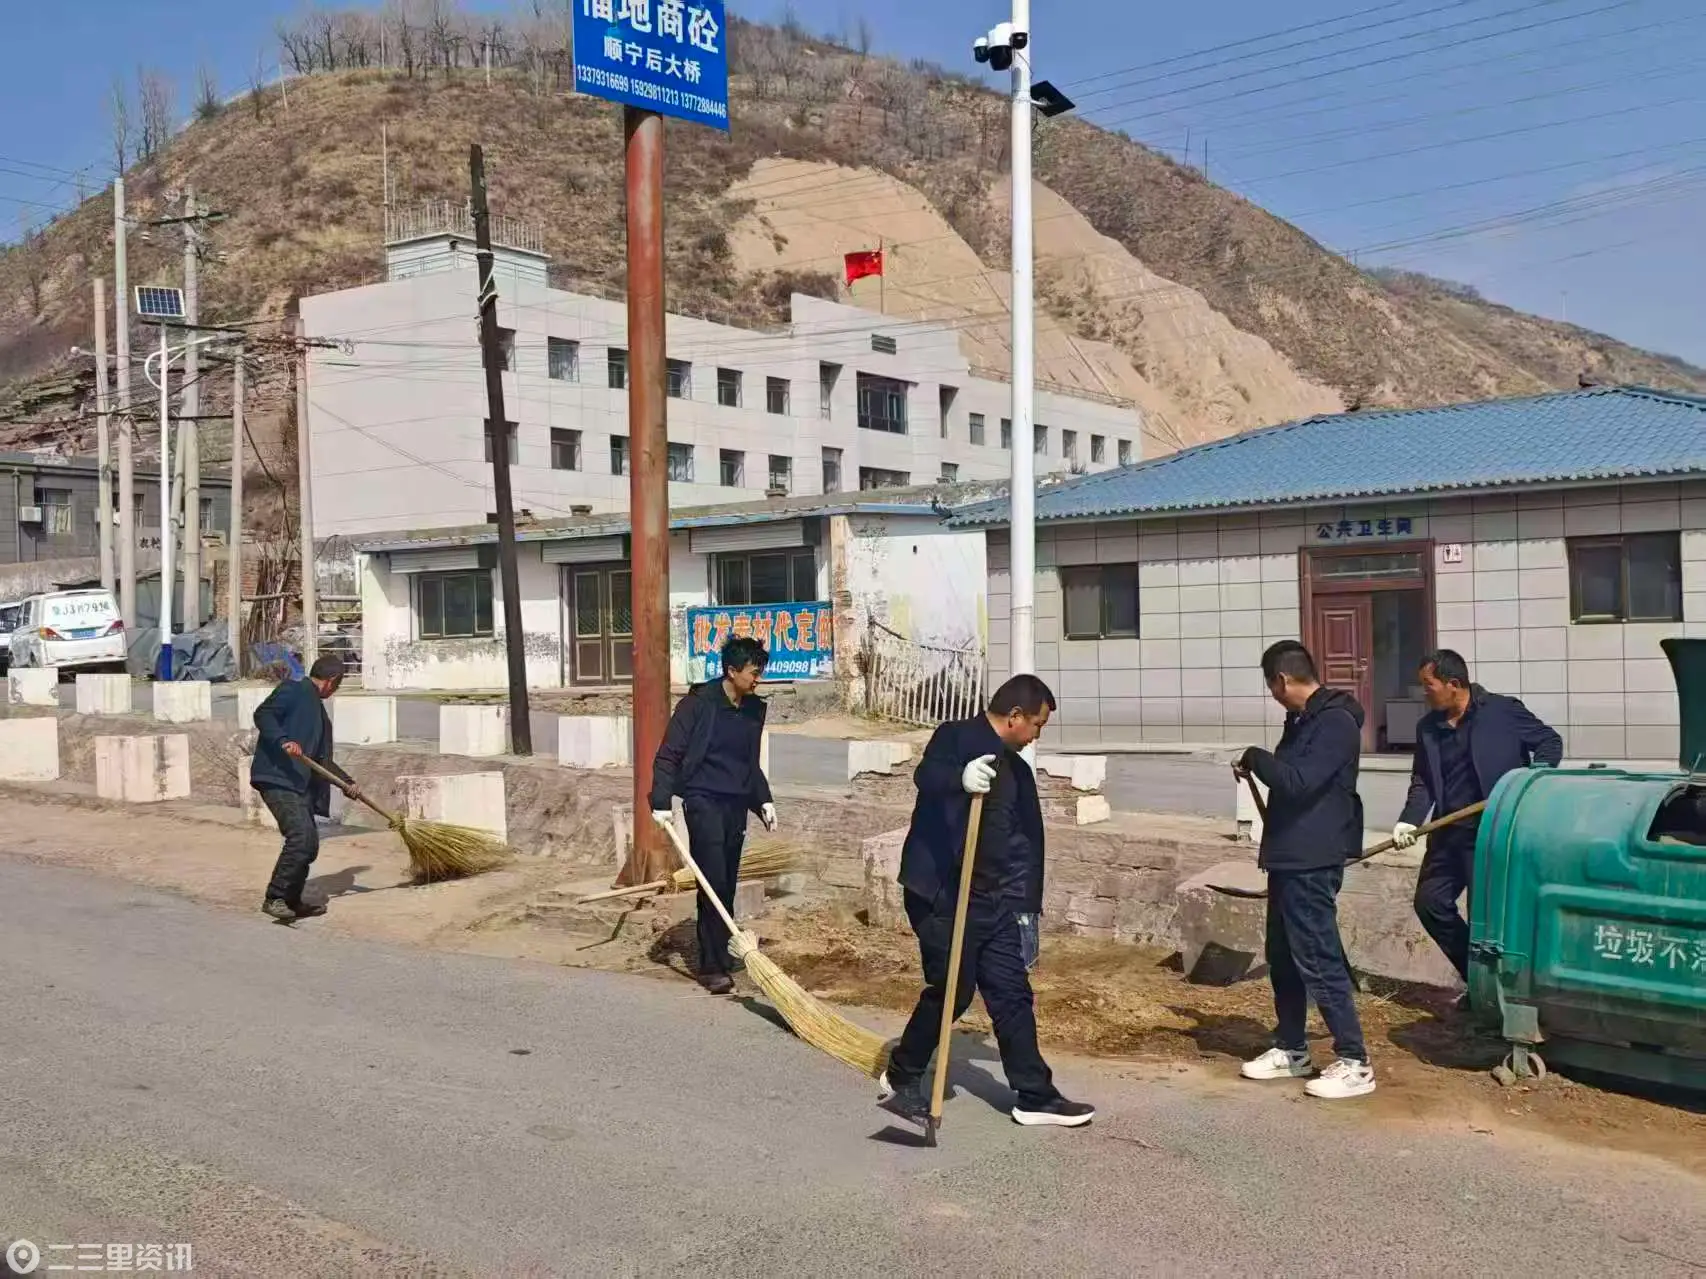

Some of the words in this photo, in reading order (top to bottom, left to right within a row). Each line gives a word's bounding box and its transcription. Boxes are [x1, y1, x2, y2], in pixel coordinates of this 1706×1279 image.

[603, 35, 702, 85] 顺宁后大桥
[1316, 517, 1413, 539] 公共卫生间
